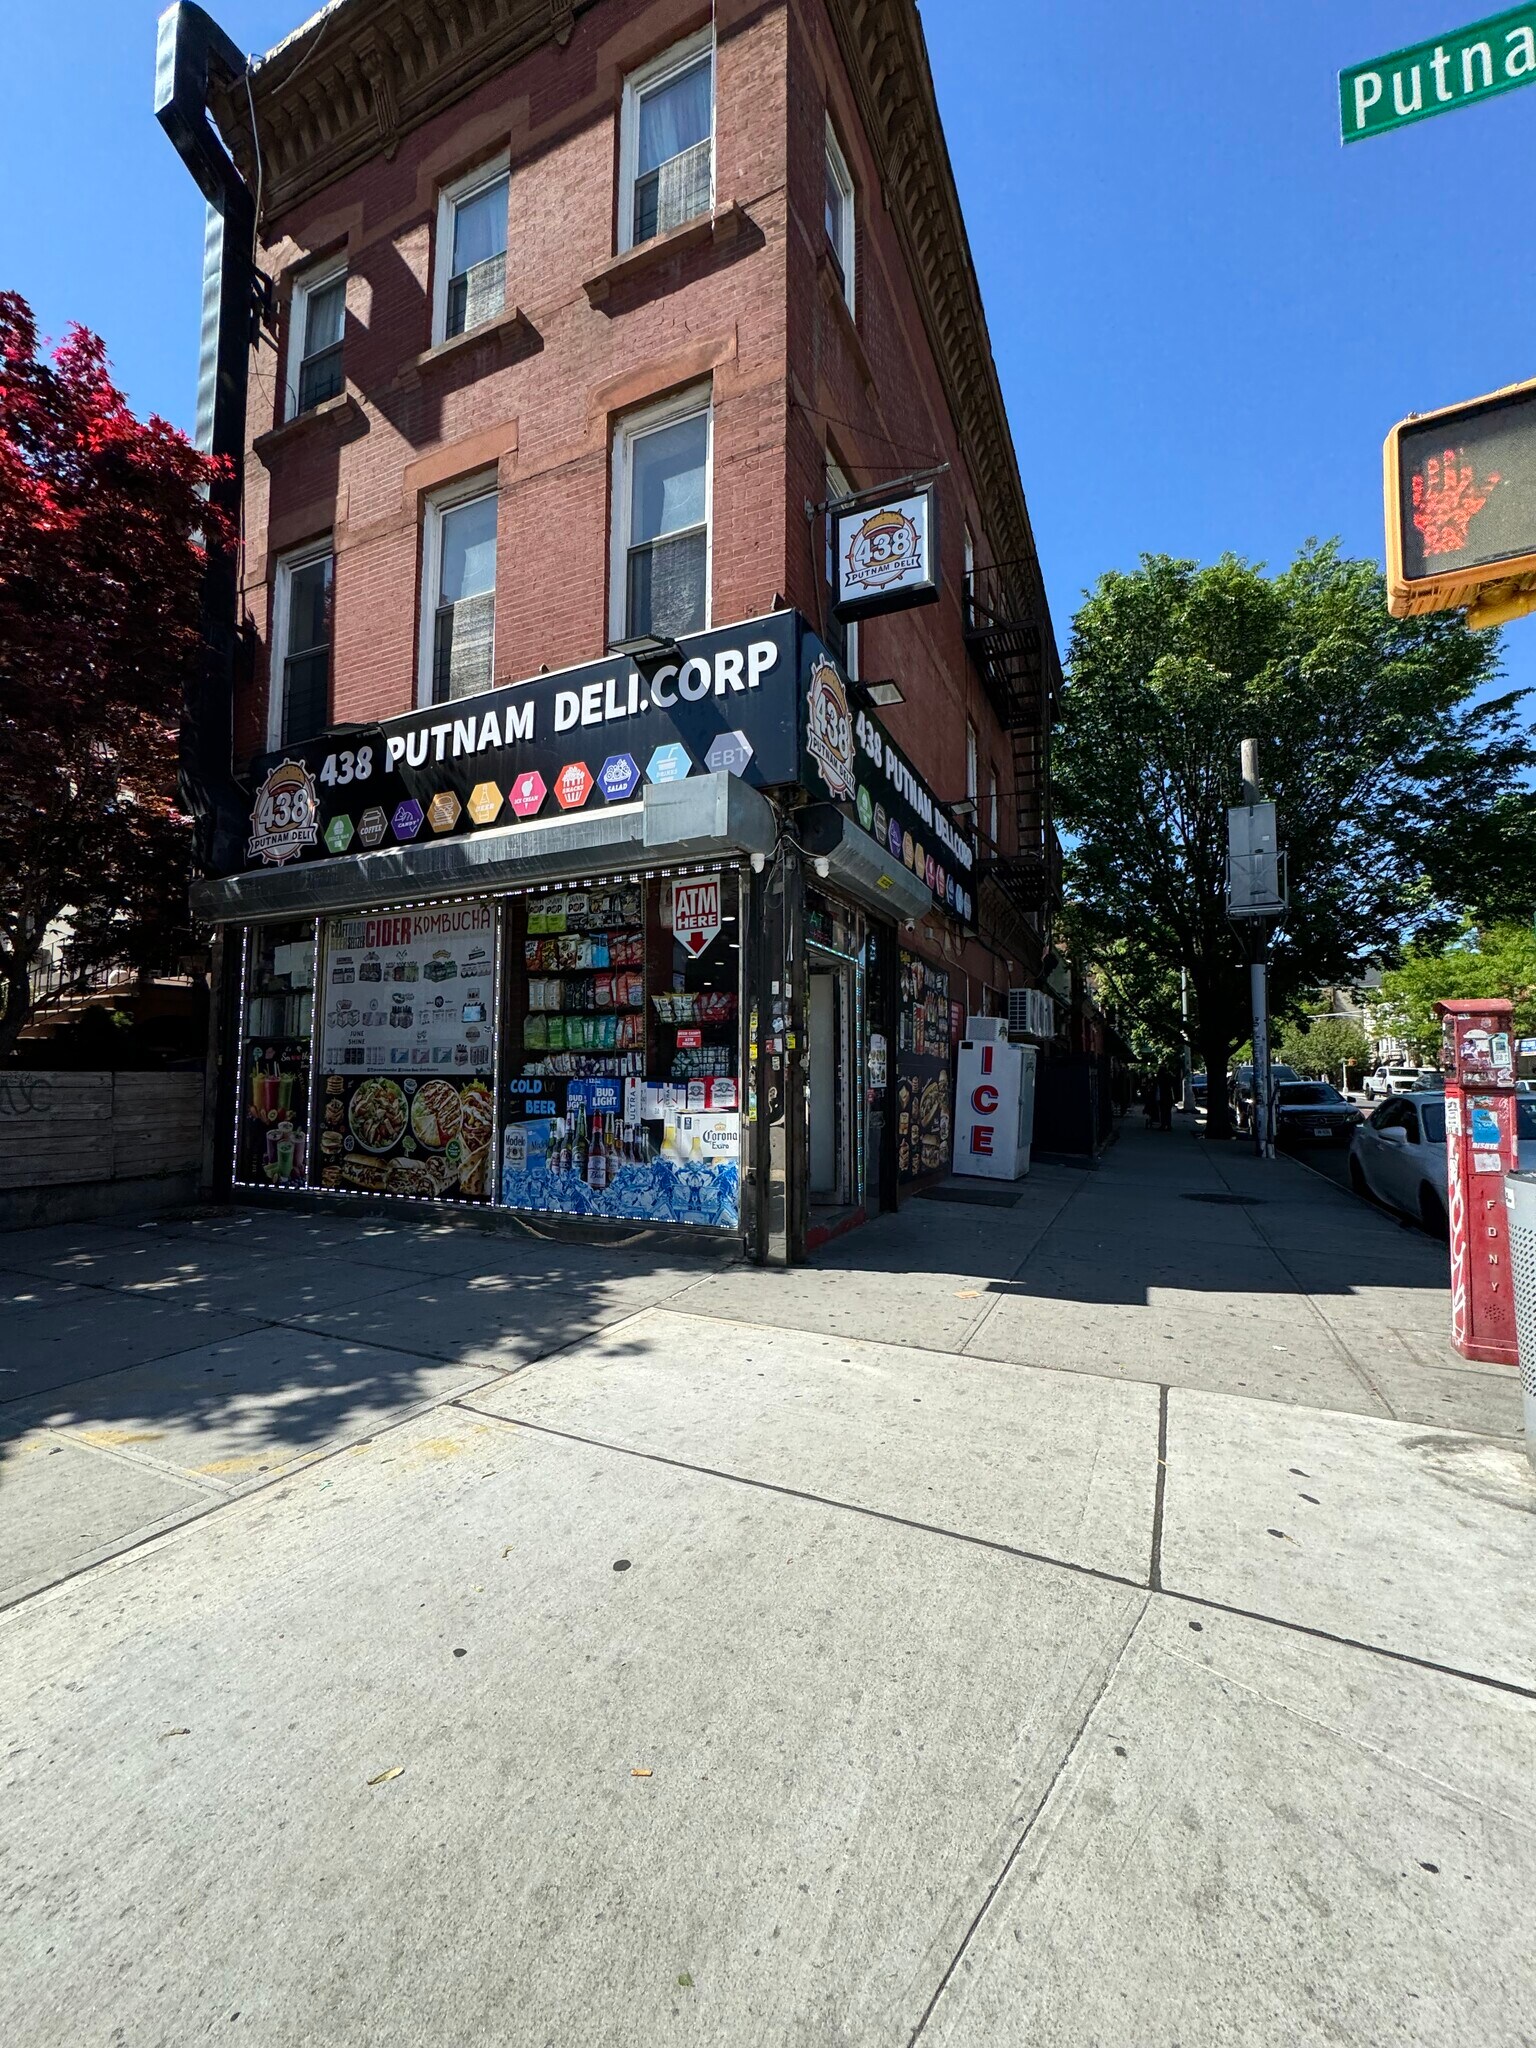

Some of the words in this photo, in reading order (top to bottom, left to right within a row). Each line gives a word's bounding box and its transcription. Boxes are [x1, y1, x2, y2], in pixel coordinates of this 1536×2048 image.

[855, 528, 911, 567] 438
[852, 565, 890, 581] PUTNAM
[894, 559, 915, 569] DELI
[816, 691, 849, 760] 438
[319, 746, 373, 787] 438
[385, 701, 534, 773] PUTNAM
[711, 746, 748, 767] EBT
[813, 737, 838, 770] PUTNAM
[856, 710, 882, 768] 438
[886, 745, 933, 828] PUTNAM
[562, 784, 584, 794] SNACKS
[607, 783, 628, 793] SALAD
[523, 795, 539, 803] CREAM
[259, 789, 309, 829] 438
[475, 802, 495, 813] BEER
[360, 824, 383, 835] COFFEE
[397, 820, 418, 828] CANDY
[254, 834, 290, 850] PUTNAM
[292, 830, 310, 841] DELI
[568, 902, 585, 913] POP
[676, 885, 717, 917] ATM
[529, 904, 544, 914] POP
[546, 904, 562, 914] POP
[365, 917, 412, 948] CIDER
[414, 908, 491, 936] KOMBUCHA
[677, 914, 717, 929] HERE
[510, 1079, 542, 1094] COLD
[596, 1087, 615, 1097] BUD
[569, 1094, 583, 1102] BUD
[592, 1096, 617, 1106] LIGHT
[970, 1045, 999, 1157] ICE
[525, 1099, 556, 1115] BEER
[702, 1129, 738, 1144] Corona
[1487, 1200, 1499, 1292] FDNY
